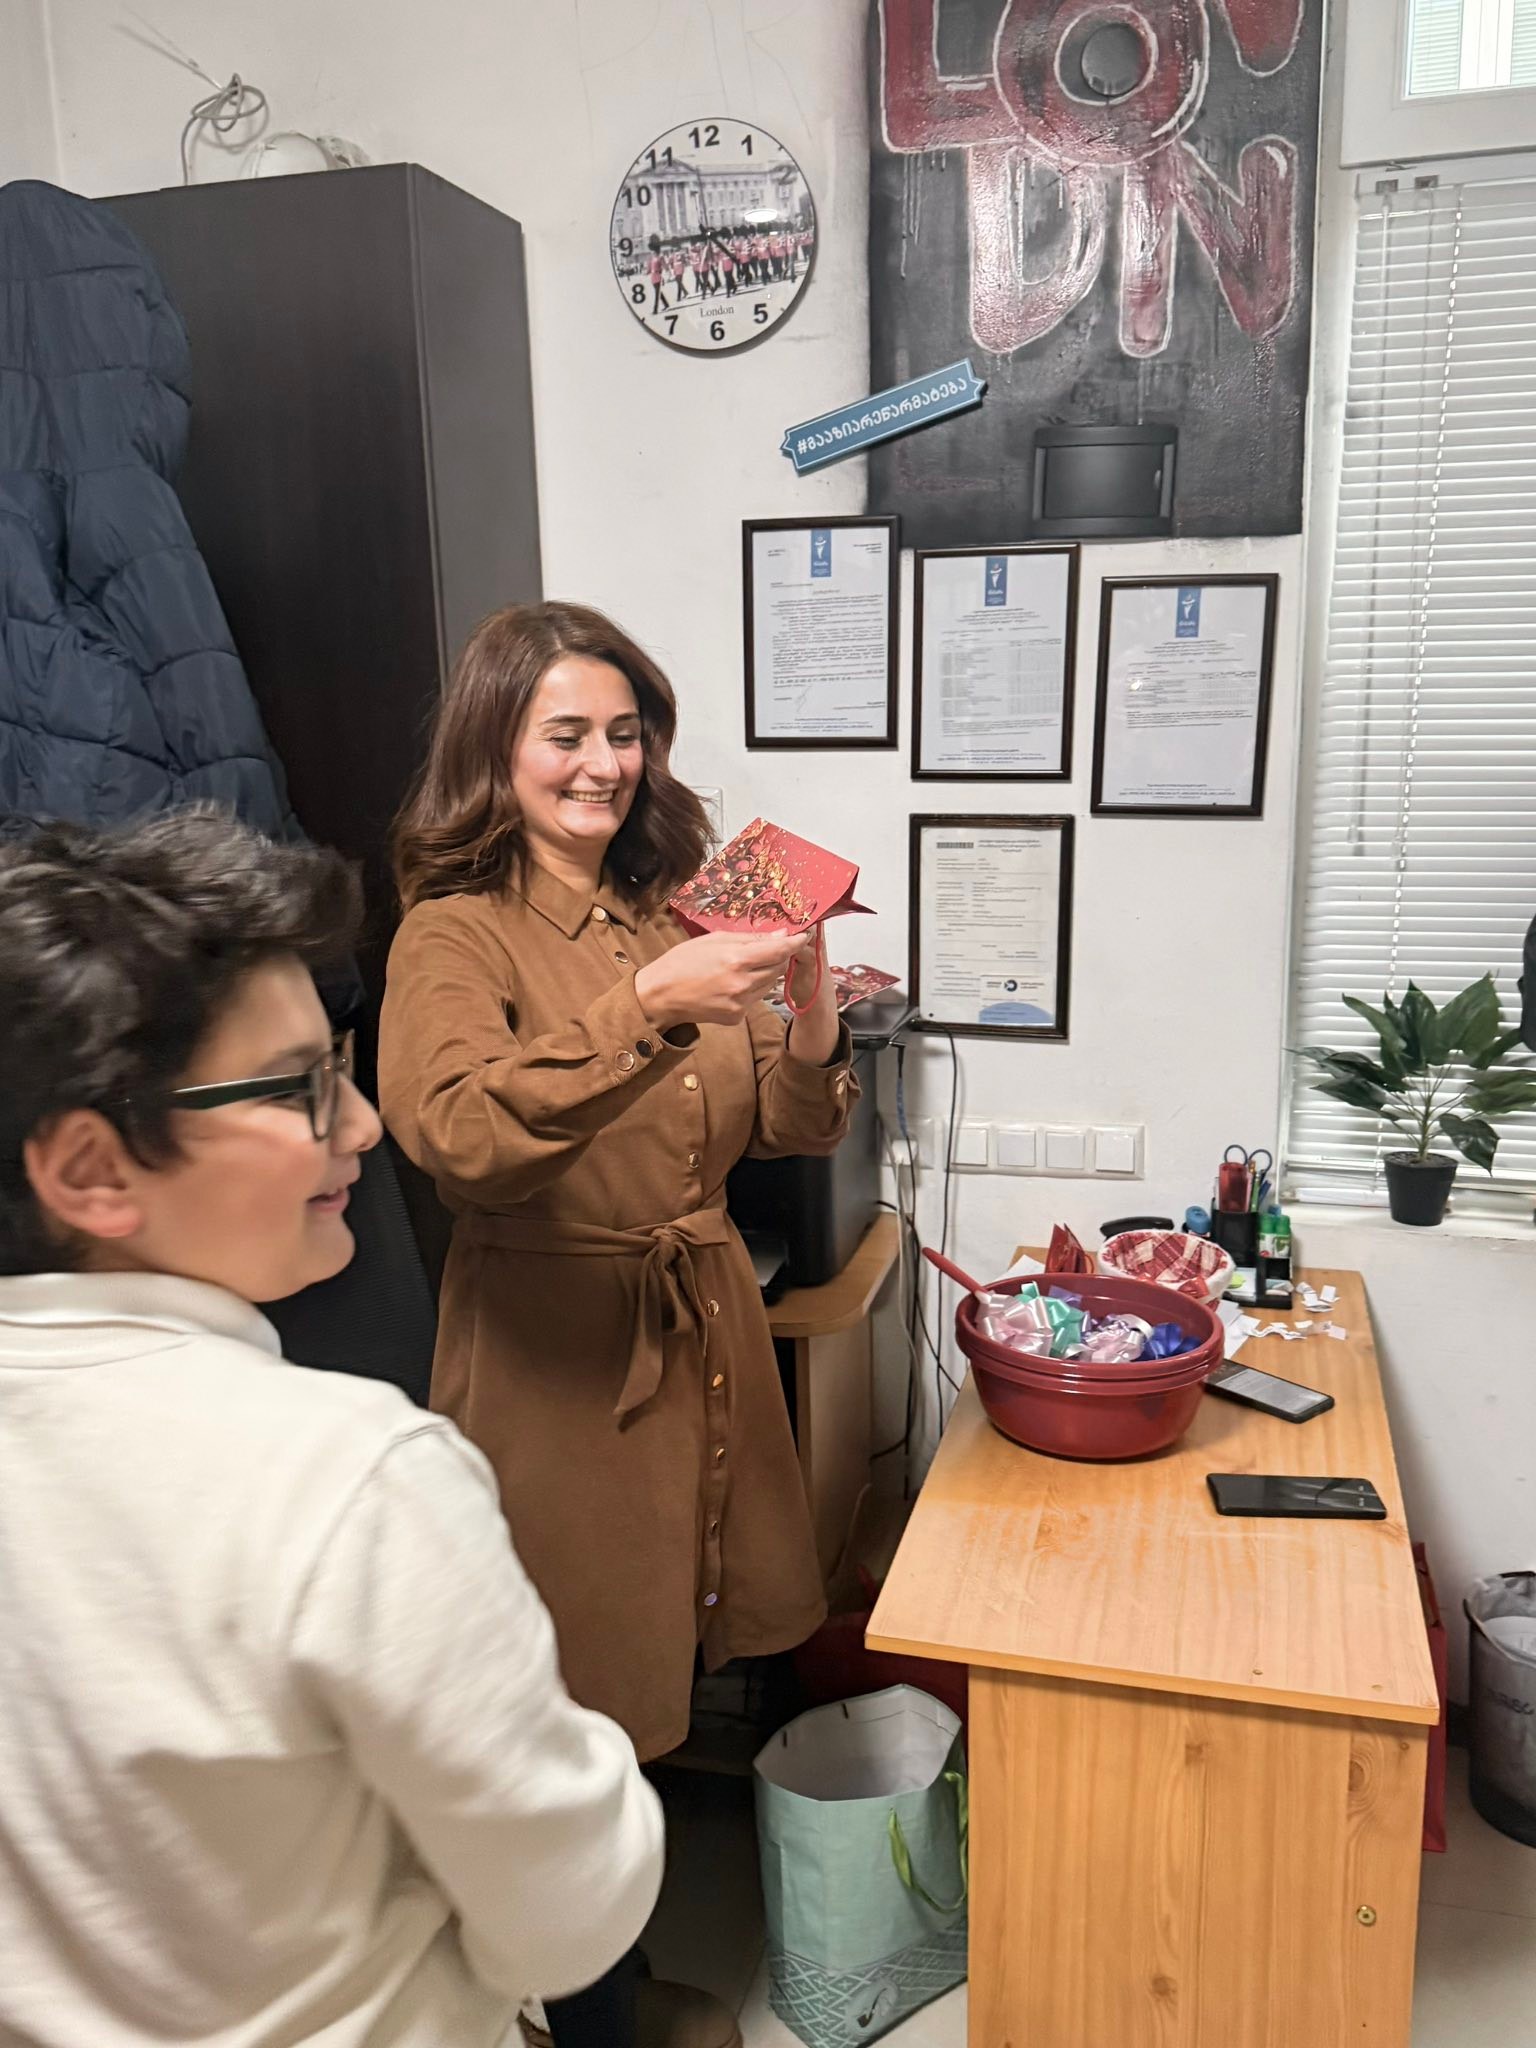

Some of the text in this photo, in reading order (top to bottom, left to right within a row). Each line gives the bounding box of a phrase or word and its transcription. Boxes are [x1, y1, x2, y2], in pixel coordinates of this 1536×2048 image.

[688, 124, 720, 148] 12
[741, 134, 753, 156] 1
[645, 146, 673, 169] 11
[621, 185, 651, 209] 10
[618, 237, 633, 258] 9
[631, 283, 646, 304] 8
[700, 305, 735, 318] London
[753, 303, 769, 324] 5
[664, 314, 679, 336] 7
[710, 320, 725, 341] 6
